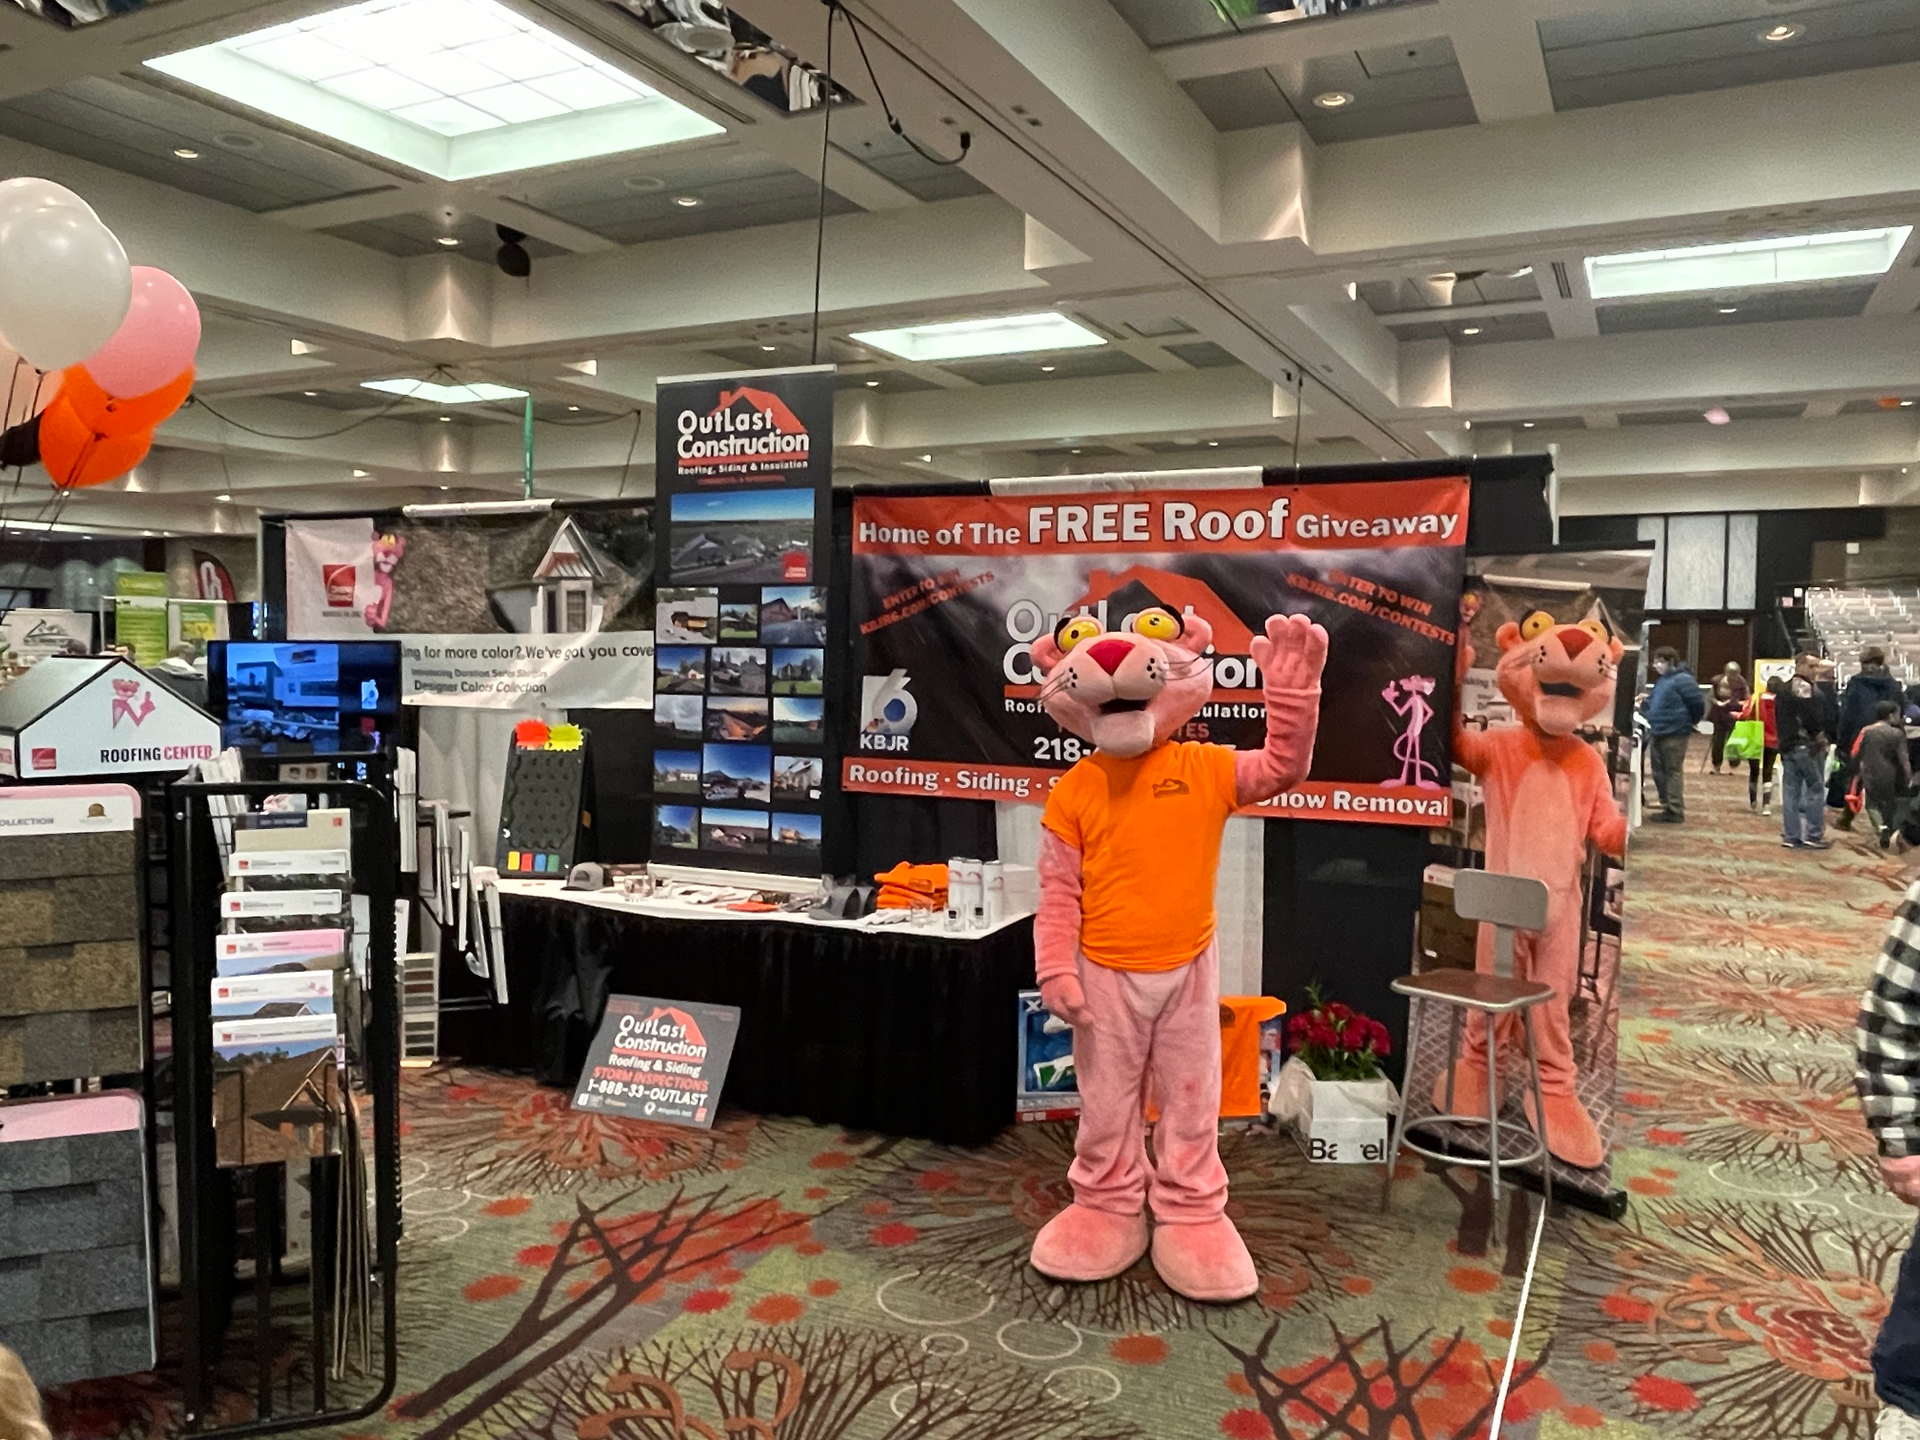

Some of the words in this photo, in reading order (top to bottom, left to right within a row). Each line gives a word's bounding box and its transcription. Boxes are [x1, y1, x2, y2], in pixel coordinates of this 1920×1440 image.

[677, 408, 774, 436] OutLast
[677, 428, 810, 459] Construction
[718, 463, 747, 474] Siding
[760, 460, 808, 471] Insulation
[859, 522, 930, 545] Home
[935, 523, 964, 544] of
[968, 522, 1020, 545] The
[1029, 503, 1150, 544] FREE
[1162, 498, 1290, 541] Roof
[1296, 513, 1459, 539] Giveaway
[1378, 583, 1399, 604] TO
[1399, 594, 1433, 616] WIN
[424, 645, 441, 659] for
[445, 647, 478, 659] more
[481, 645, 522, 659] color?
[525, 645, 562, 659] We've
[564, 645, 585, 661] got
[588, 646, 617, 661] you
[622, 646, 654, 657] cove
[414, 680, 458, 694] Designer
[461, 681, 493, 693] Colors
[100, 747, 161, 763] ROOFING
[164, 745, 213, 761] CENTER
[859, 733, 909, 751] KBJR
[849, 764, 939, 791] Roofing
[956, 770, 1031, 798] Siding
[1333, 790, 1448, 817] Removal
[0, 817, 54, 827] OLLECTION
[619, 1014, 687, 1040] OutLast
[614, 1031, 708, 1058] Construction
[593, 1066, 634, 1083] STORM
[633, 1069, 710, 1093] INSPECTIONS
[608, 1054, 652, 1072] Roofing
[652, 1058, 663, 1072] &
[664, 1060, 702, 1079] Siding
[587, 1078, 708, 1106] 1-888-33-OUTLAST
